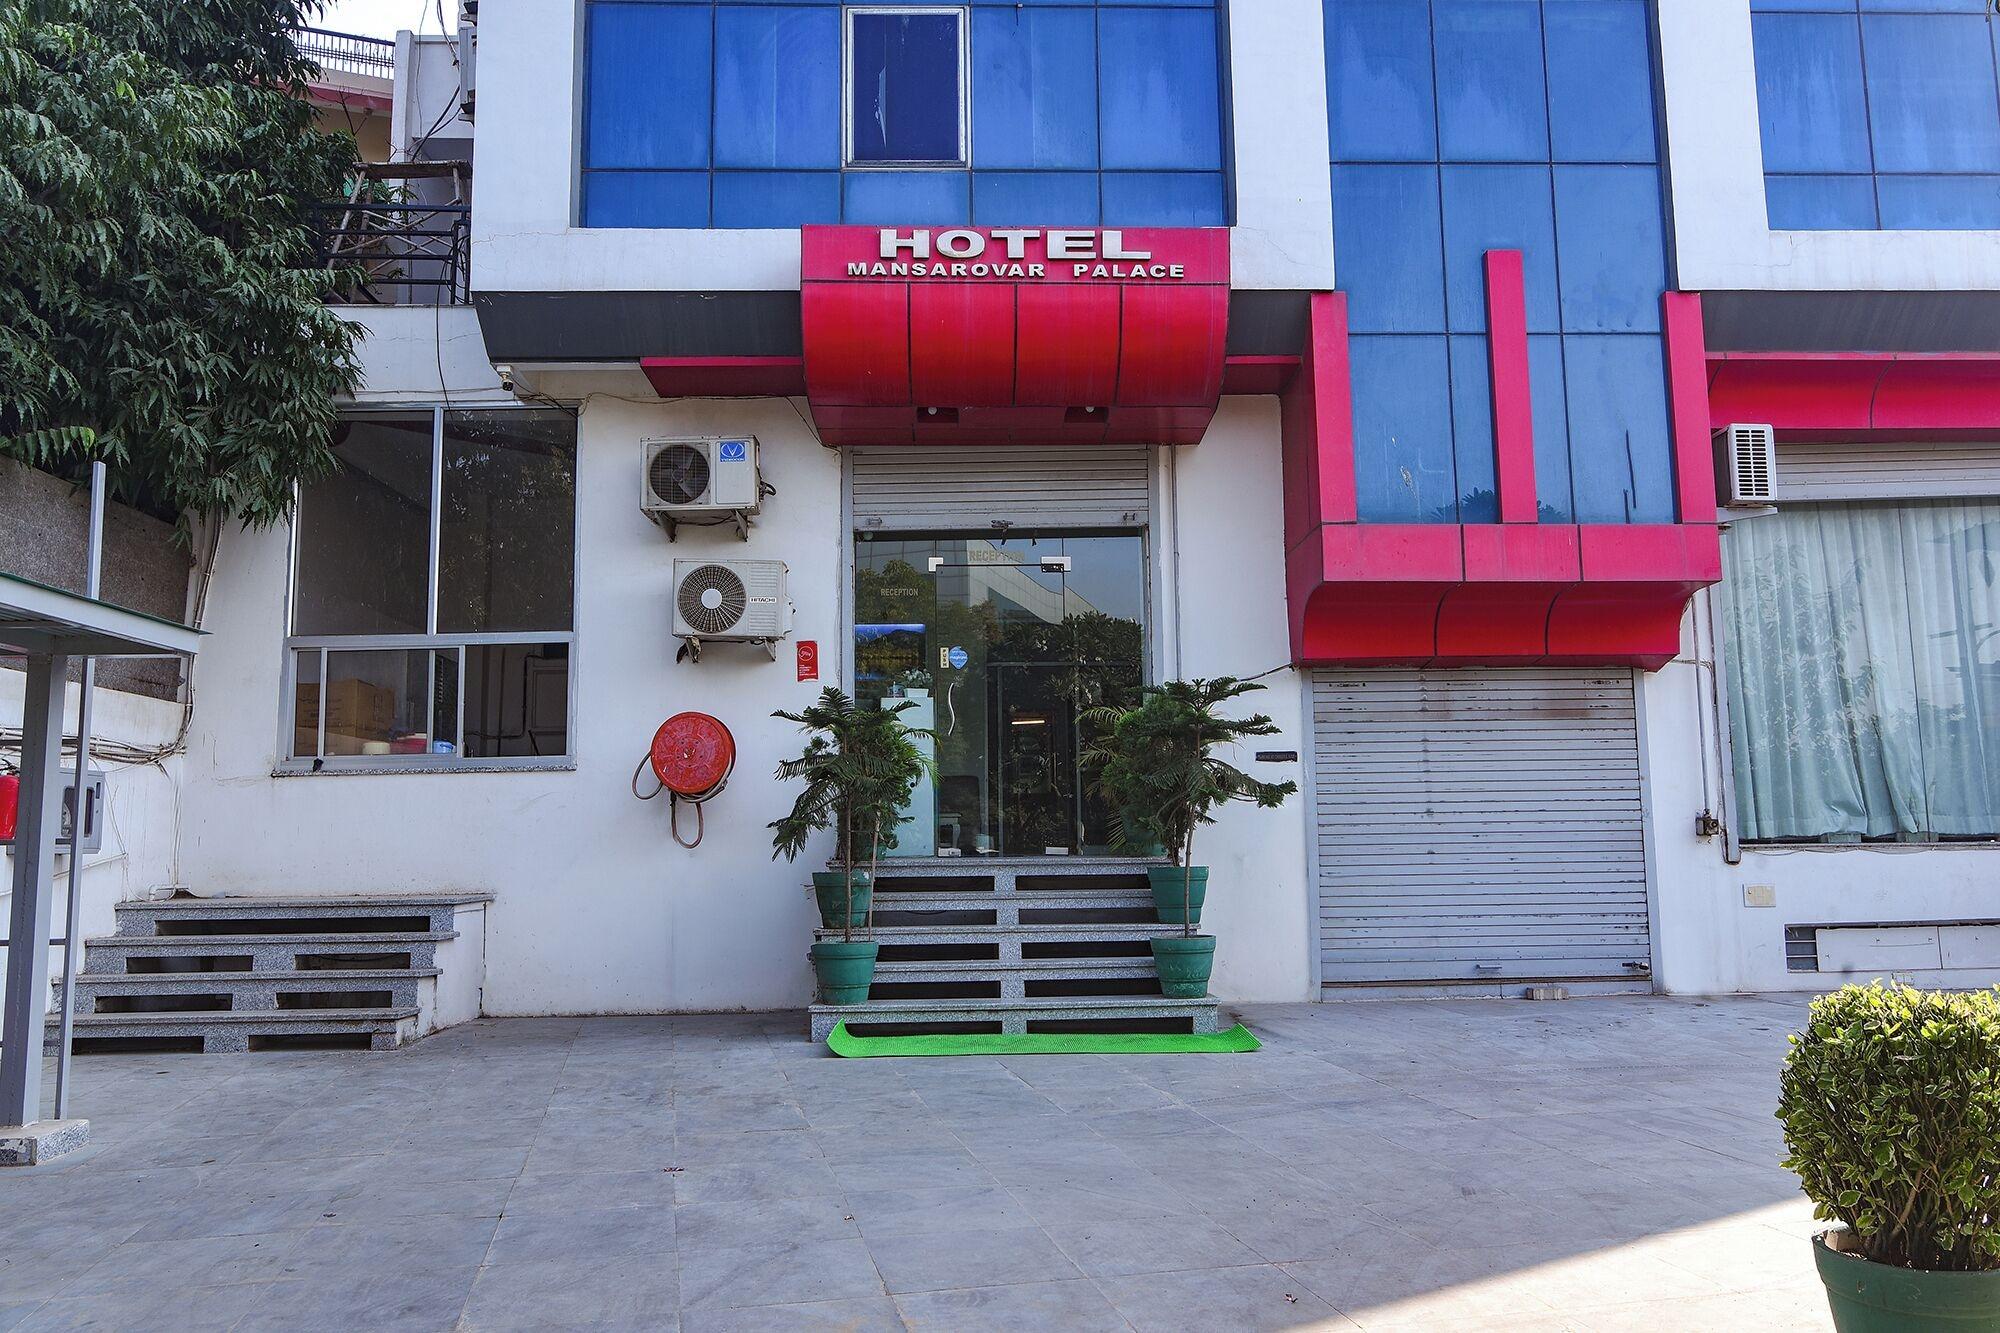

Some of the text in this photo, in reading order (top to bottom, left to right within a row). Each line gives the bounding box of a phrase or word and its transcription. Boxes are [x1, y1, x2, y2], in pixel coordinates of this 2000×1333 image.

[879, 229, 1152, 260] HOTEL
[847, 262, 1184, 279] MANSAROVAR PALACE
[880, 588, 919, 596] RECEPTION
